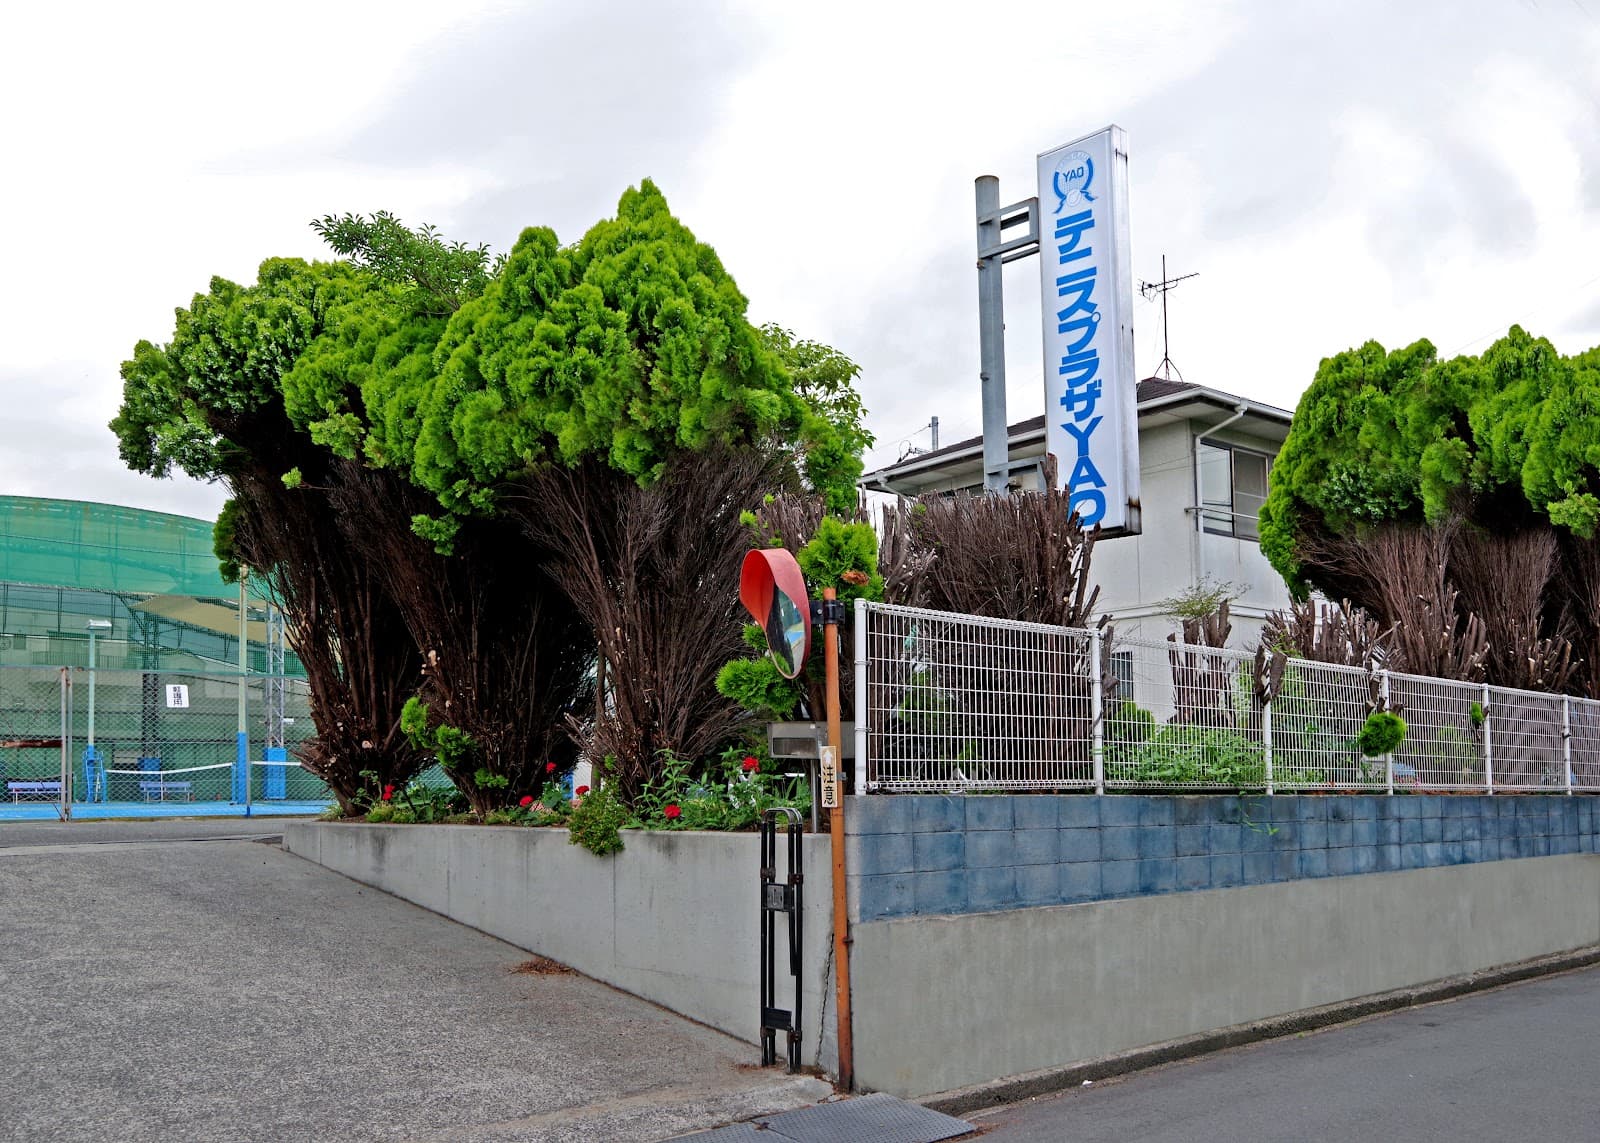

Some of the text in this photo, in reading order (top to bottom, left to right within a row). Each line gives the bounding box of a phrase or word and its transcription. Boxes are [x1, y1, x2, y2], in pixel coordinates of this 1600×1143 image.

[1062, 166, 1084, 182] YAO
[1054, 208, 1107, 527] テニスプラザYAO
[823, 764, 834, 805] 注意
